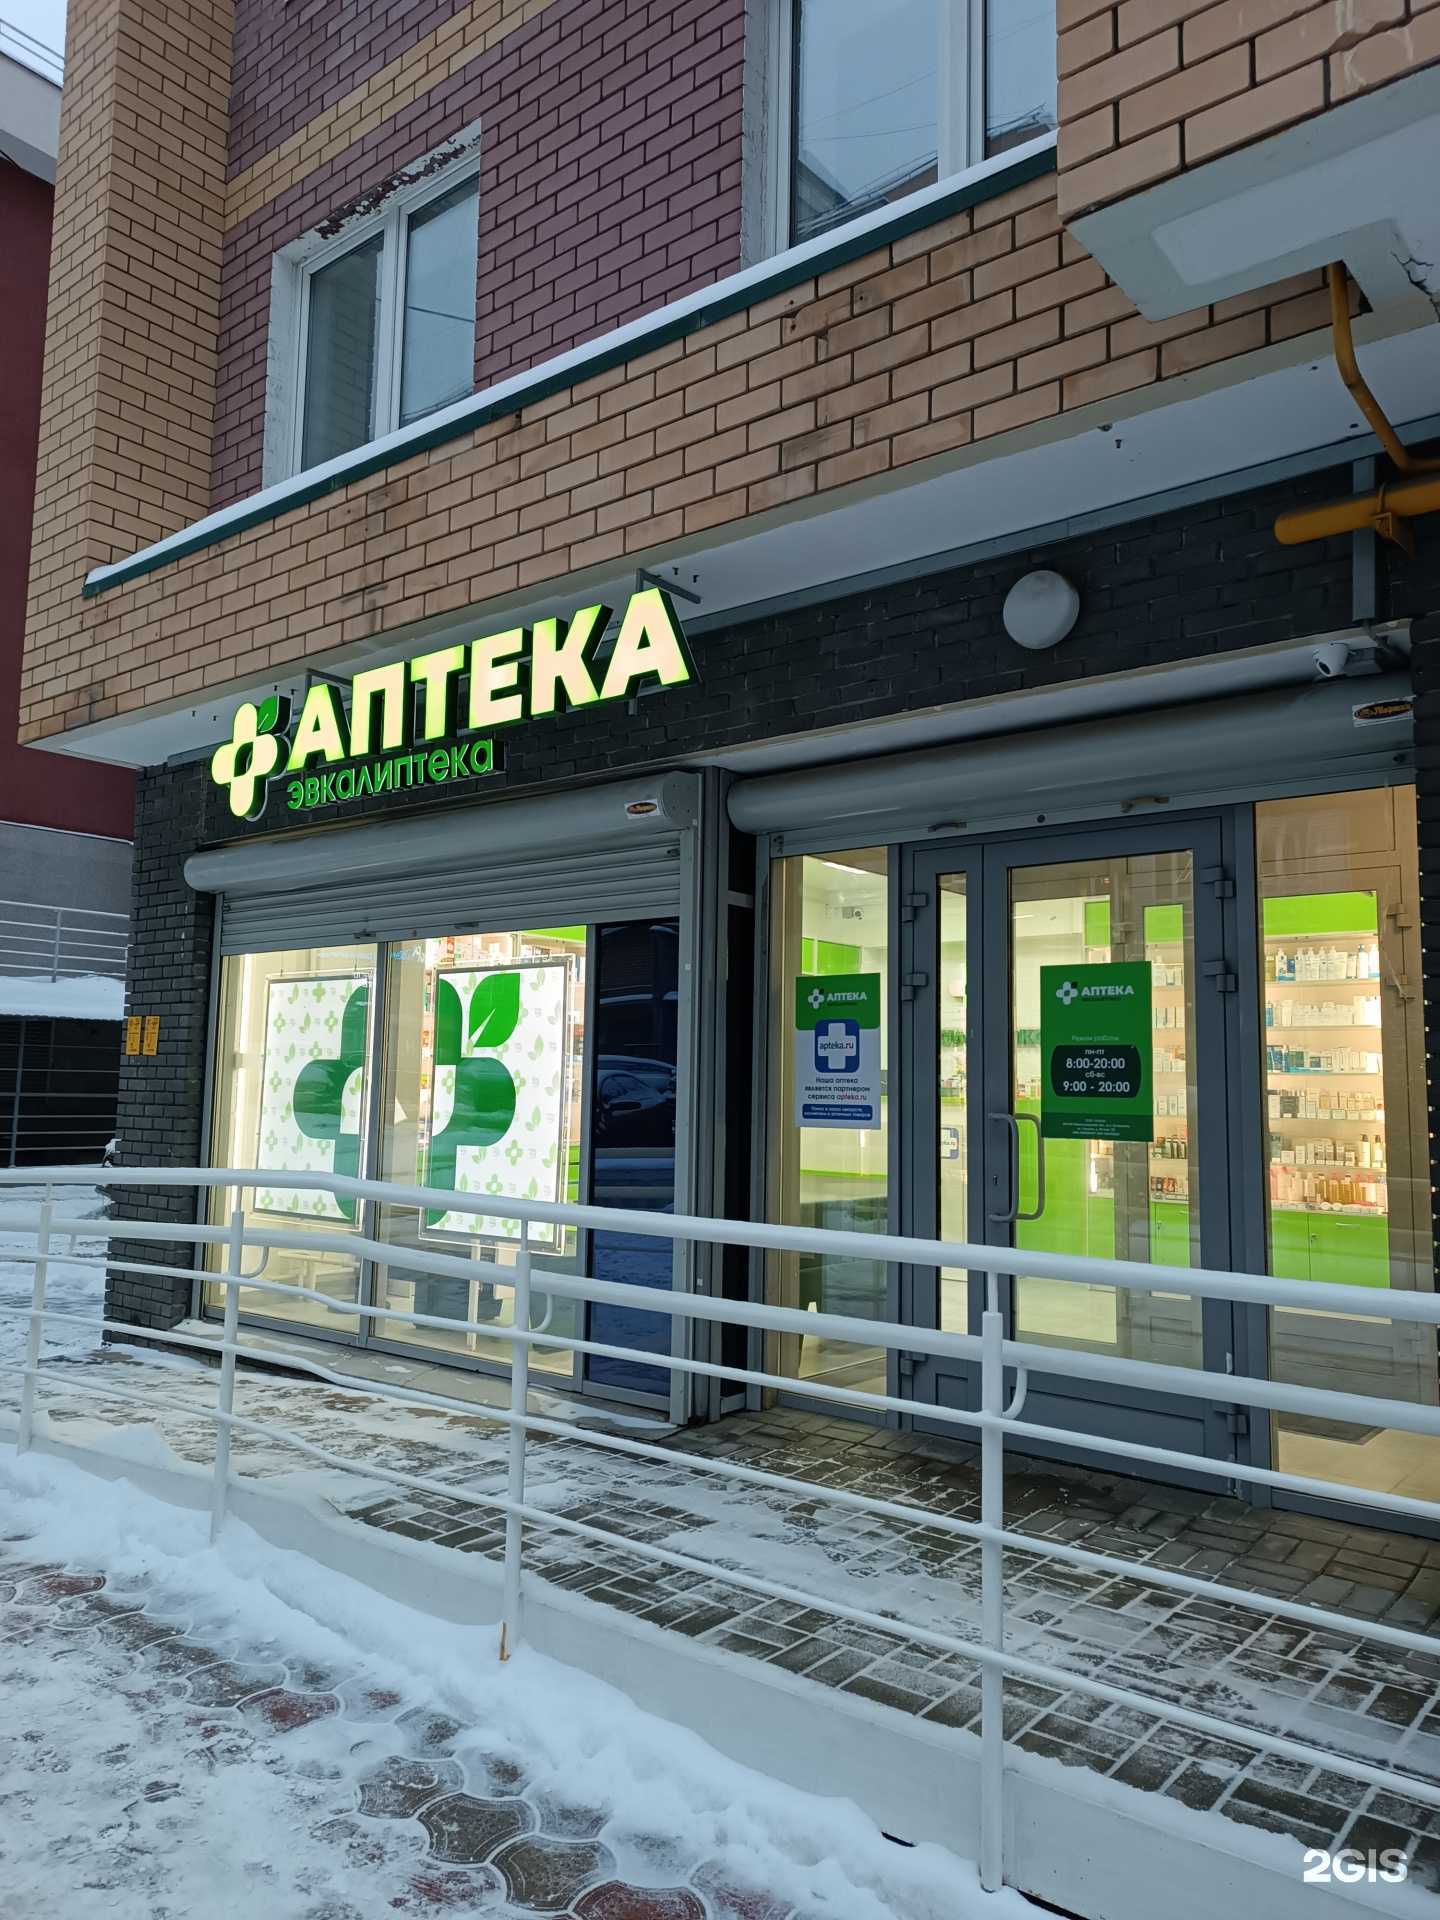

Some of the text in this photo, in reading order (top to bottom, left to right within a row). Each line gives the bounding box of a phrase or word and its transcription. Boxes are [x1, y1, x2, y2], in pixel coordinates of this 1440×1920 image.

[287, 587, 692, 771] АПТЕКА
[286, 738, 494, 810] эвкалиптека
[826, 991, 868, 1002] АПТЕКА
[1081, 984, 1135, 997] АПТЕКА
[819, 1041, 854, 1051] apteka.ru
[1065, 1057, 1126, 1069] 8:00-20:00
[1062, 1080, 1087, 1092] 9:00
[1098, 1081, 1131, 1093] 20:00
